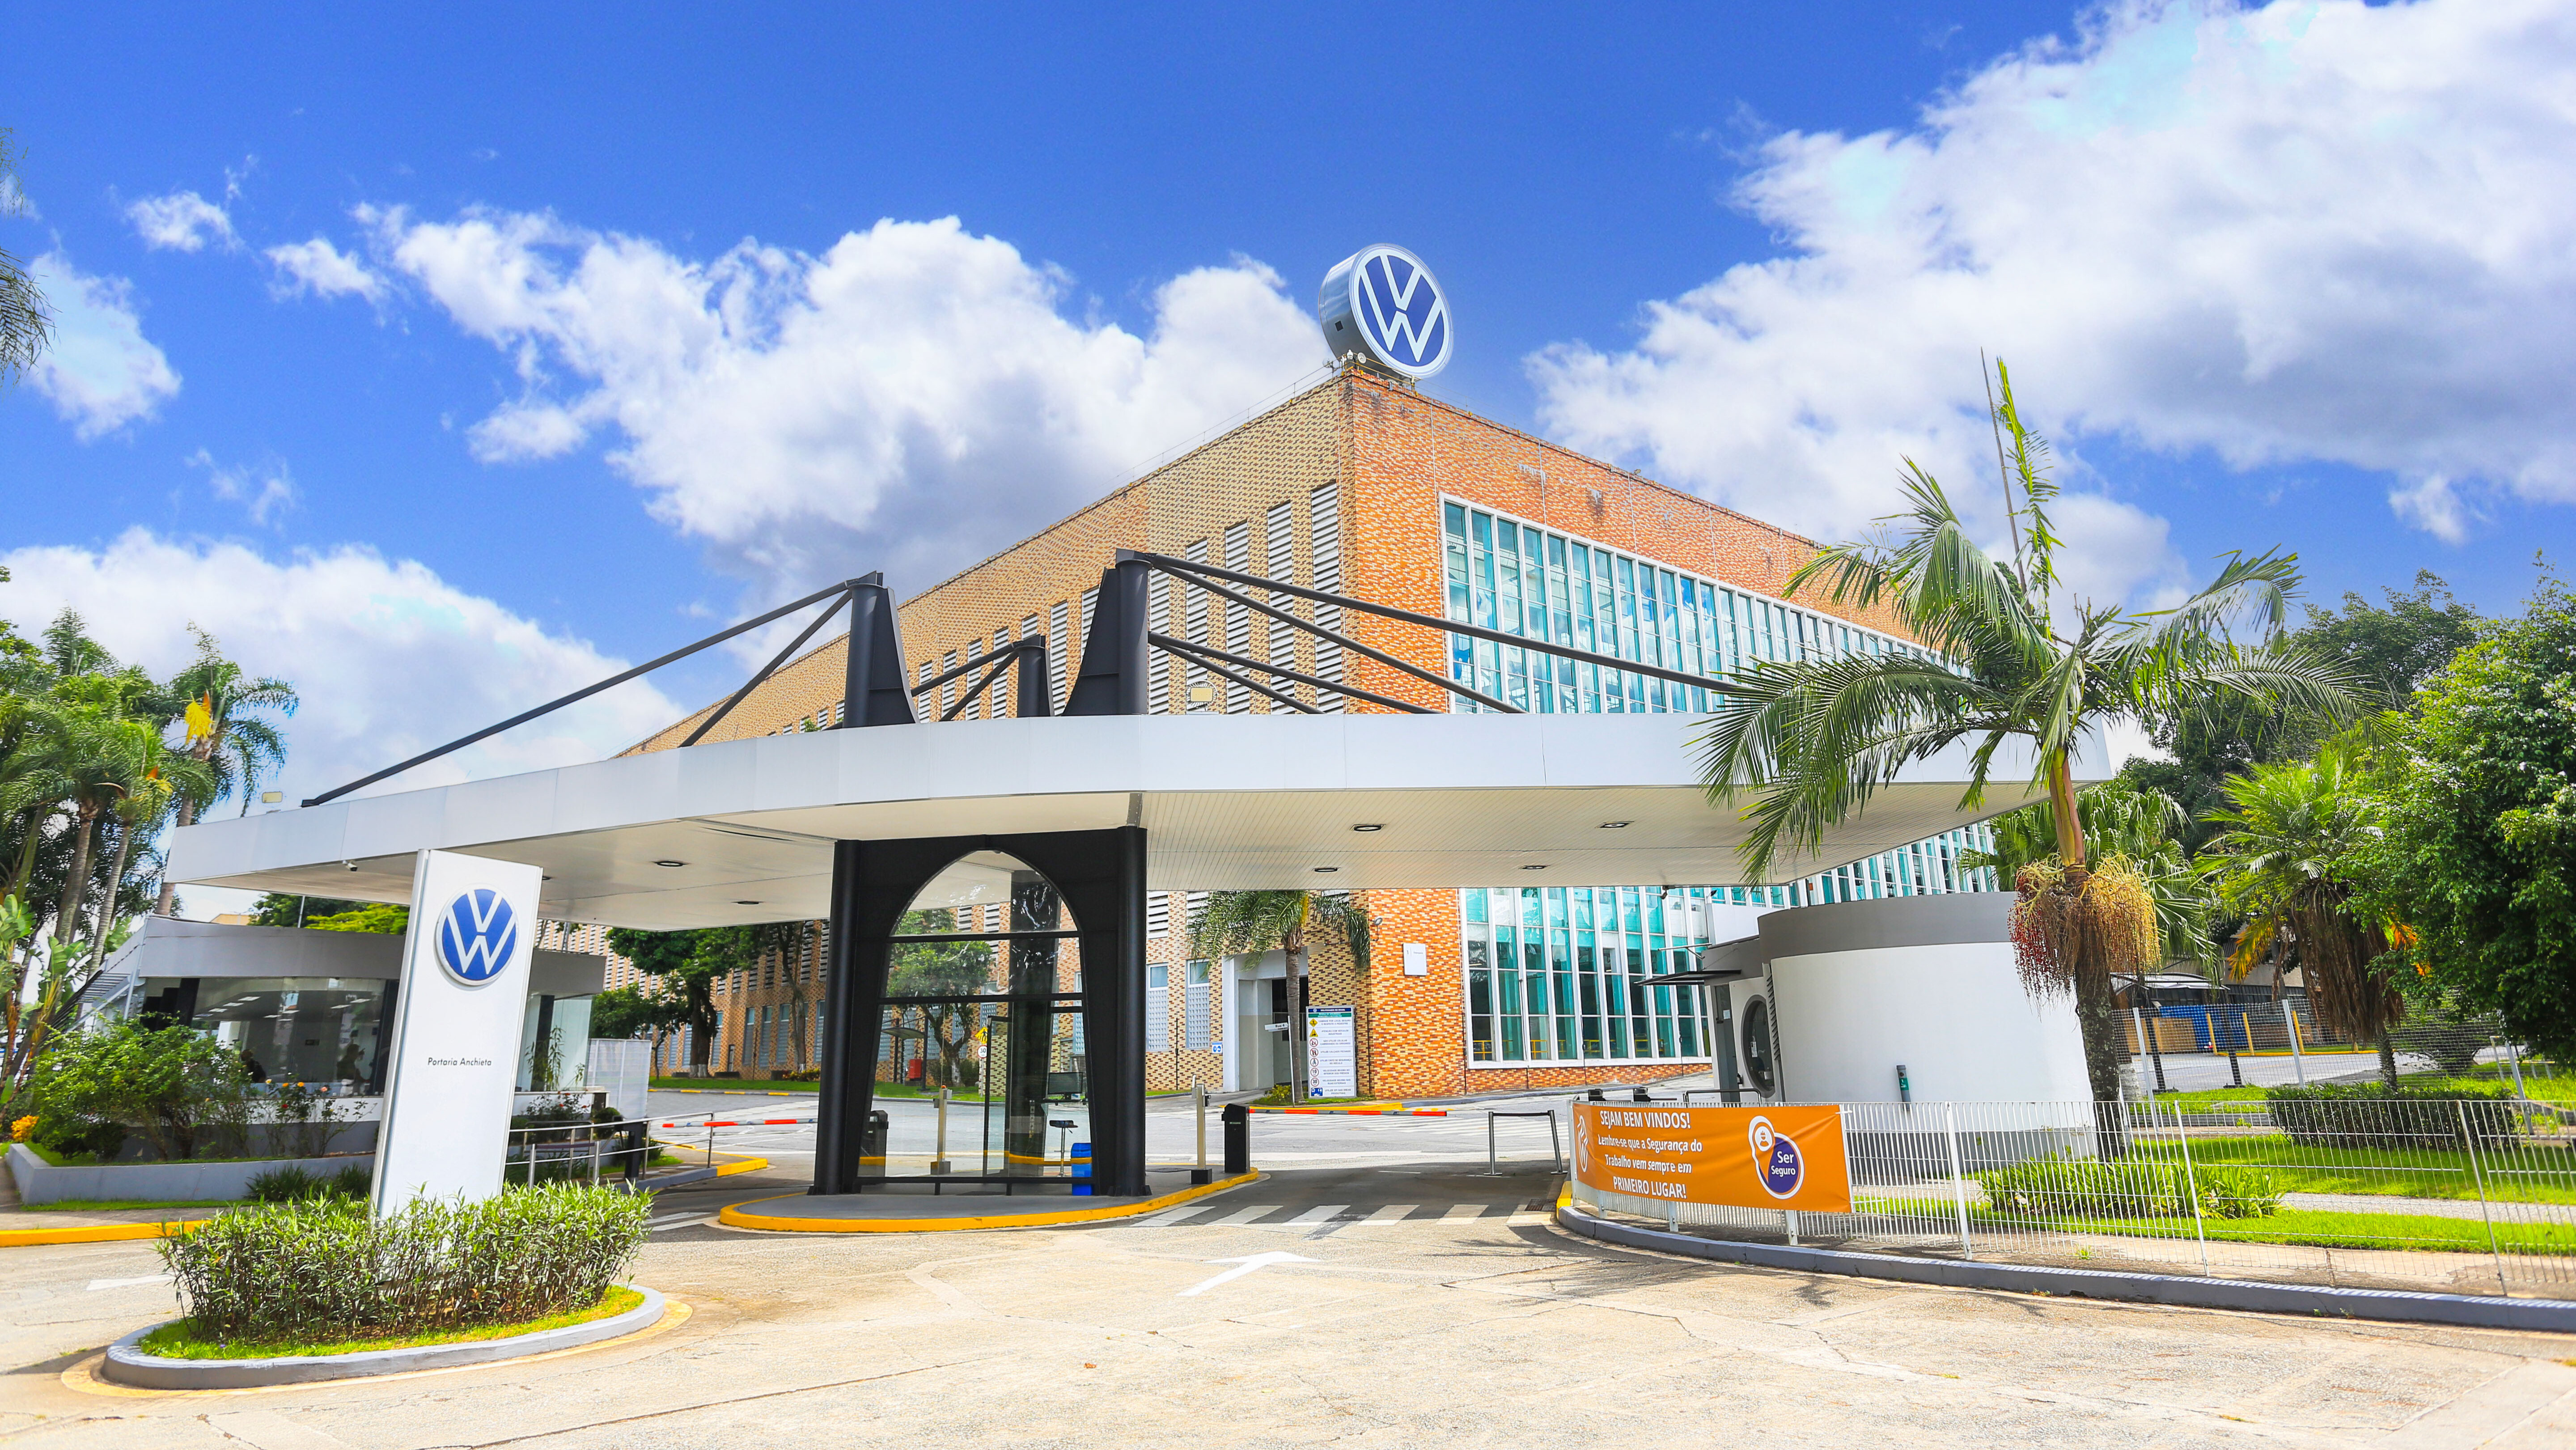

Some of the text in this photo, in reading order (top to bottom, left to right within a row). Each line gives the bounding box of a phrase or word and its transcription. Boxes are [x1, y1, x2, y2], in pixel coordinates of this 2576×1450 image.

[1354, 250, 1448, 371] VW
[438, 887, 517, 982] VW
[428, 1057, 491, 1066] Portaria Anchieta
[1600, 1111, 1690, 1129] SEJAM BEM VINDOS!
[1598, 1134, 1702, 1155] Lembre-se que a Segurança do
[1605, 1154, 1692, 1175] Trabalho vem sempre em
[1777, 1151, 1794, 1163] Ser
[1771, 1165, 1796, 1177] Seguro
[1613, 1176, 1686, 1199] PRIMEIRO LUGAR!
